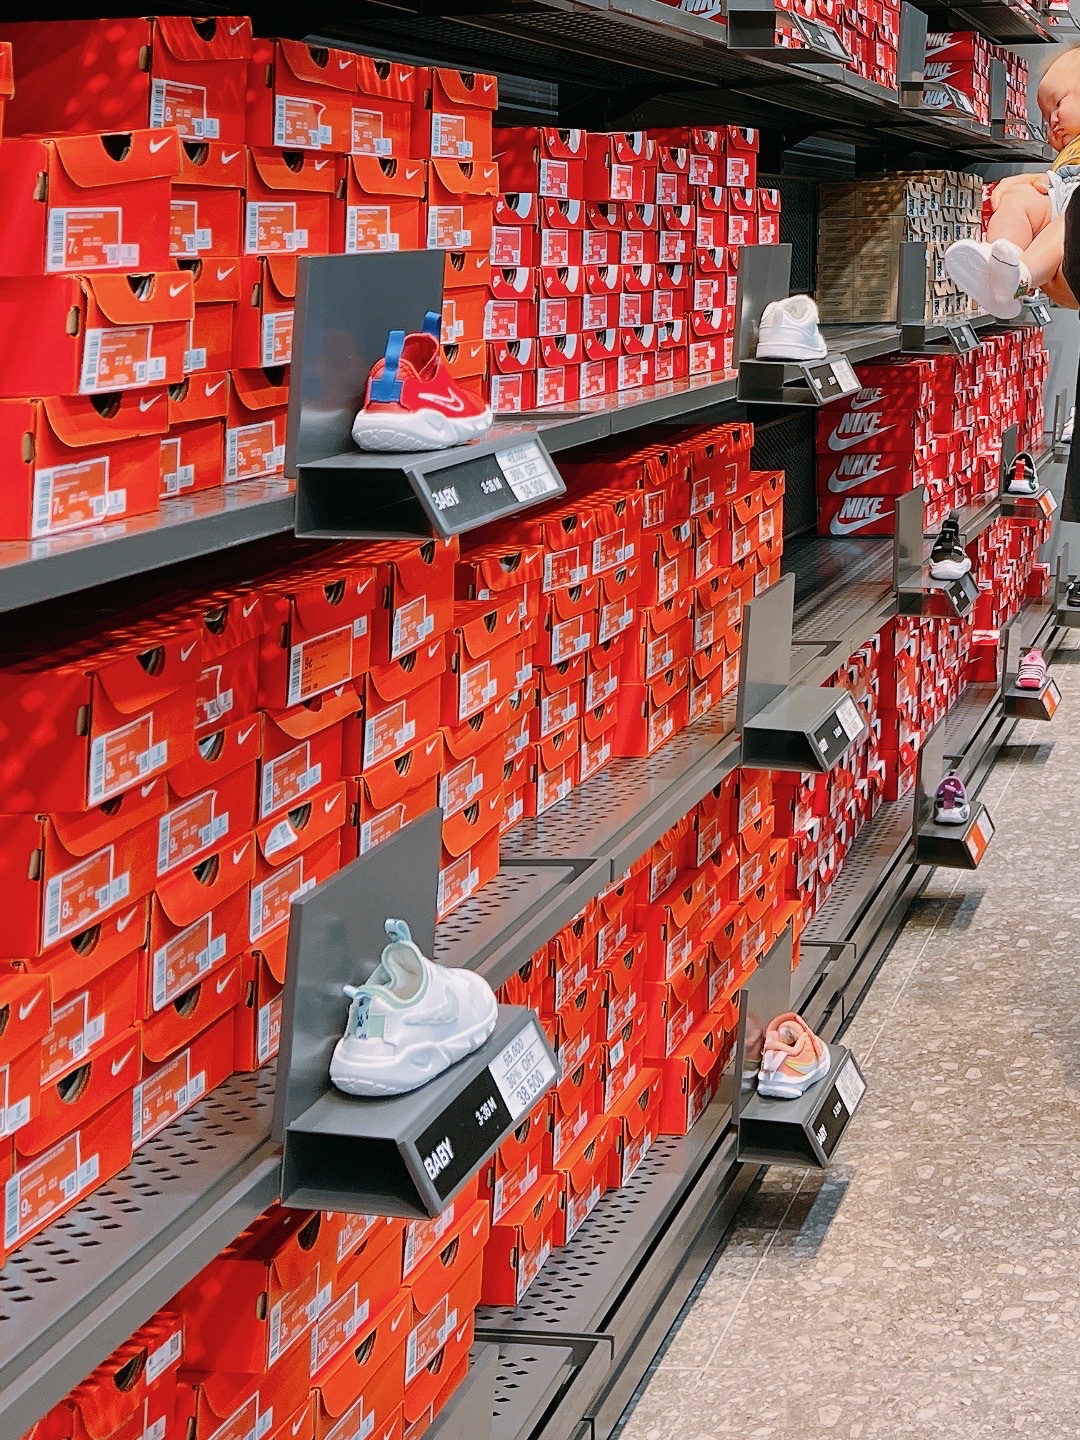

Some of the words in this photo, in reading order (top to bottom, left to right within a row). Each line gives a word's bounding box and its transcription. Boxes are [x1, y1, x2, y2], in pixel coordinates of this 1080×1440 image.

[926, 33, 953, 46] NIKE
[924, 63, 952, 76] NIKE
[857, 388, 882, 400] NIKE
[838, 412, 882, 433] NIKE
[838, 455, 882, 475] NIKE
[839, 497, 884, 518] NIKE
[522, 1051, 534, 1071] OFF
[423, 1136, 454, 1181] BABY
